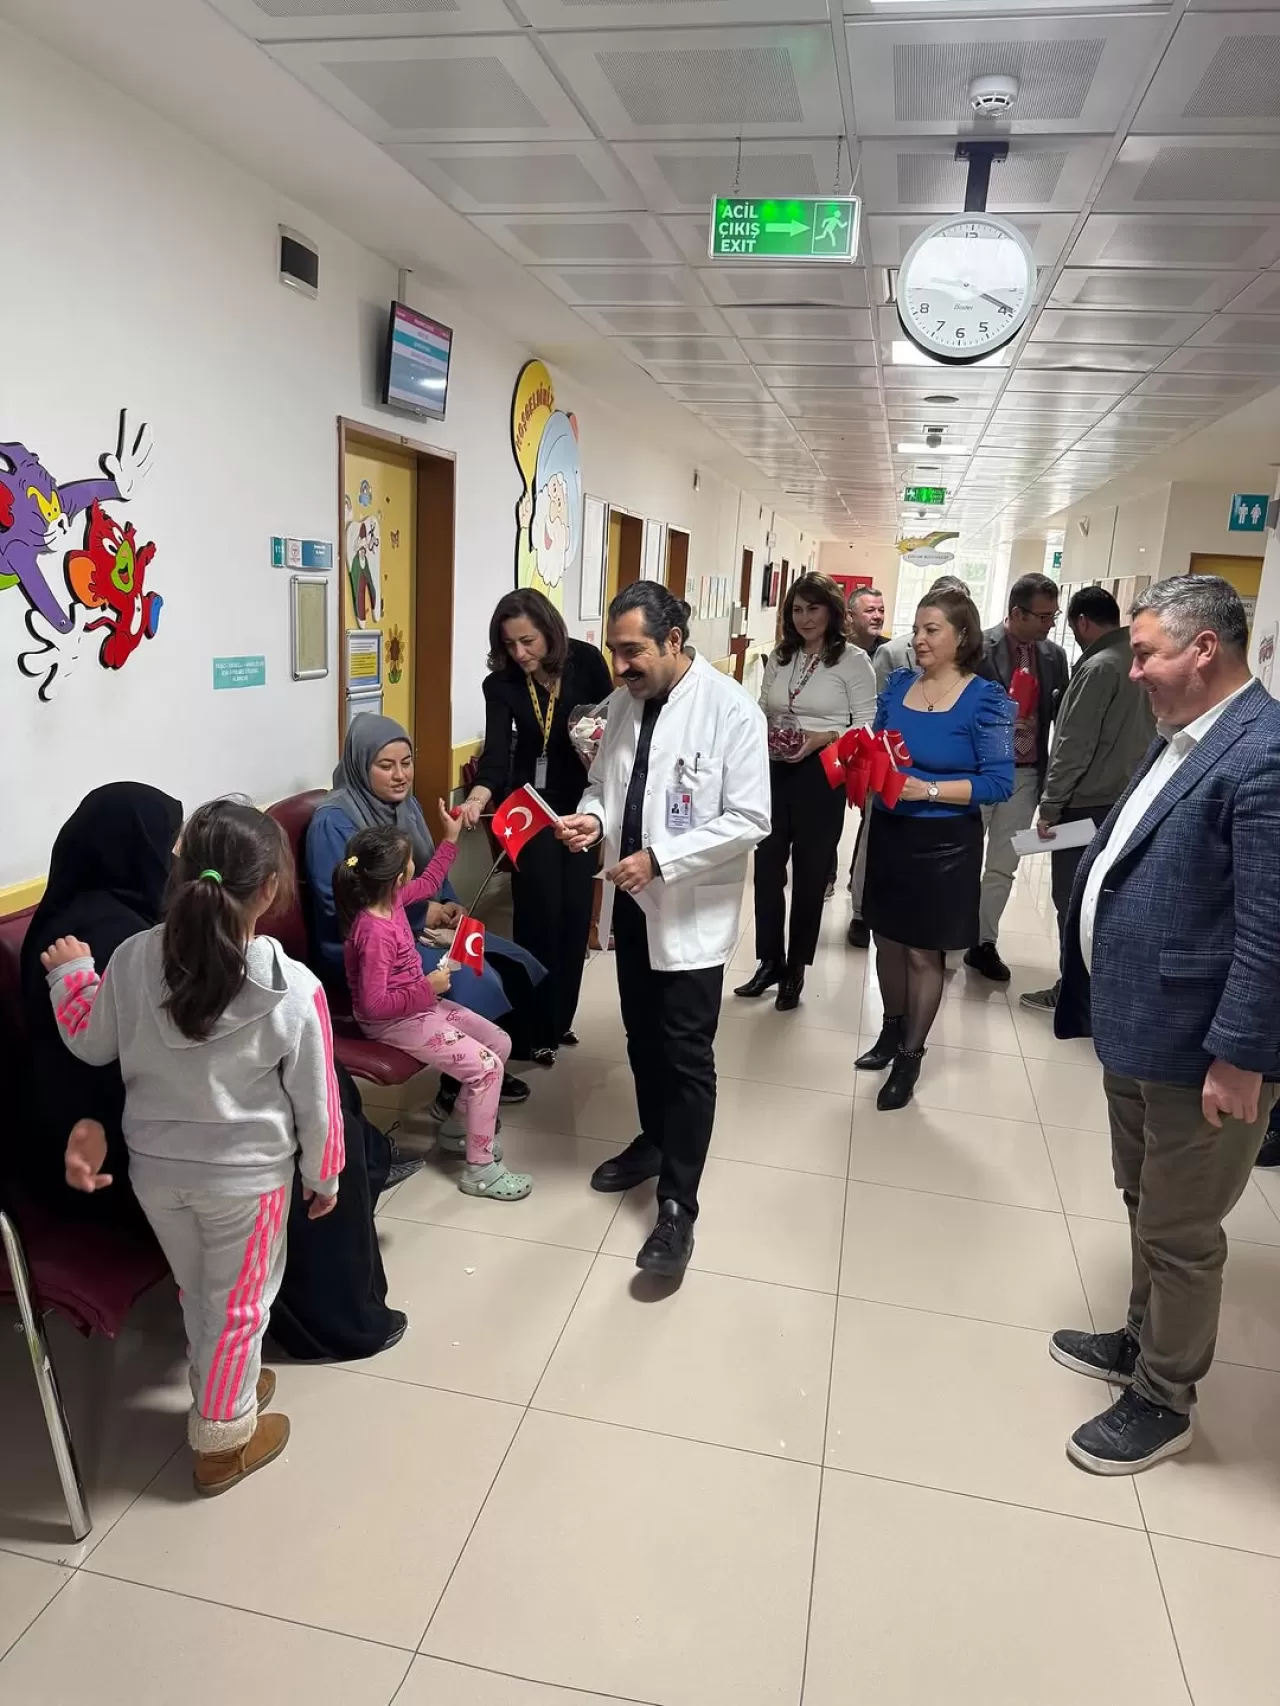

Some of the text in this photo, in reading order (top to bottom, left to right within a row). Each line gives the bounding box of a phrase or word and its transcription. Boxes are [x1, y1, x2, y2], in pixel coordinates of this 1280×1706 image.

[722, 202, 759, 219] ACİL
[718, 222, 760, 238] ÇIKIŞ
[720, 239, 757, 253] EXIT
[919, 303, 930, 314] 8
[997, 305, 1009, 315] 4
[935, 320, 946, 331] 7
[978, 321, 989, 333] 5
[955, 327, 965, 339] 6
